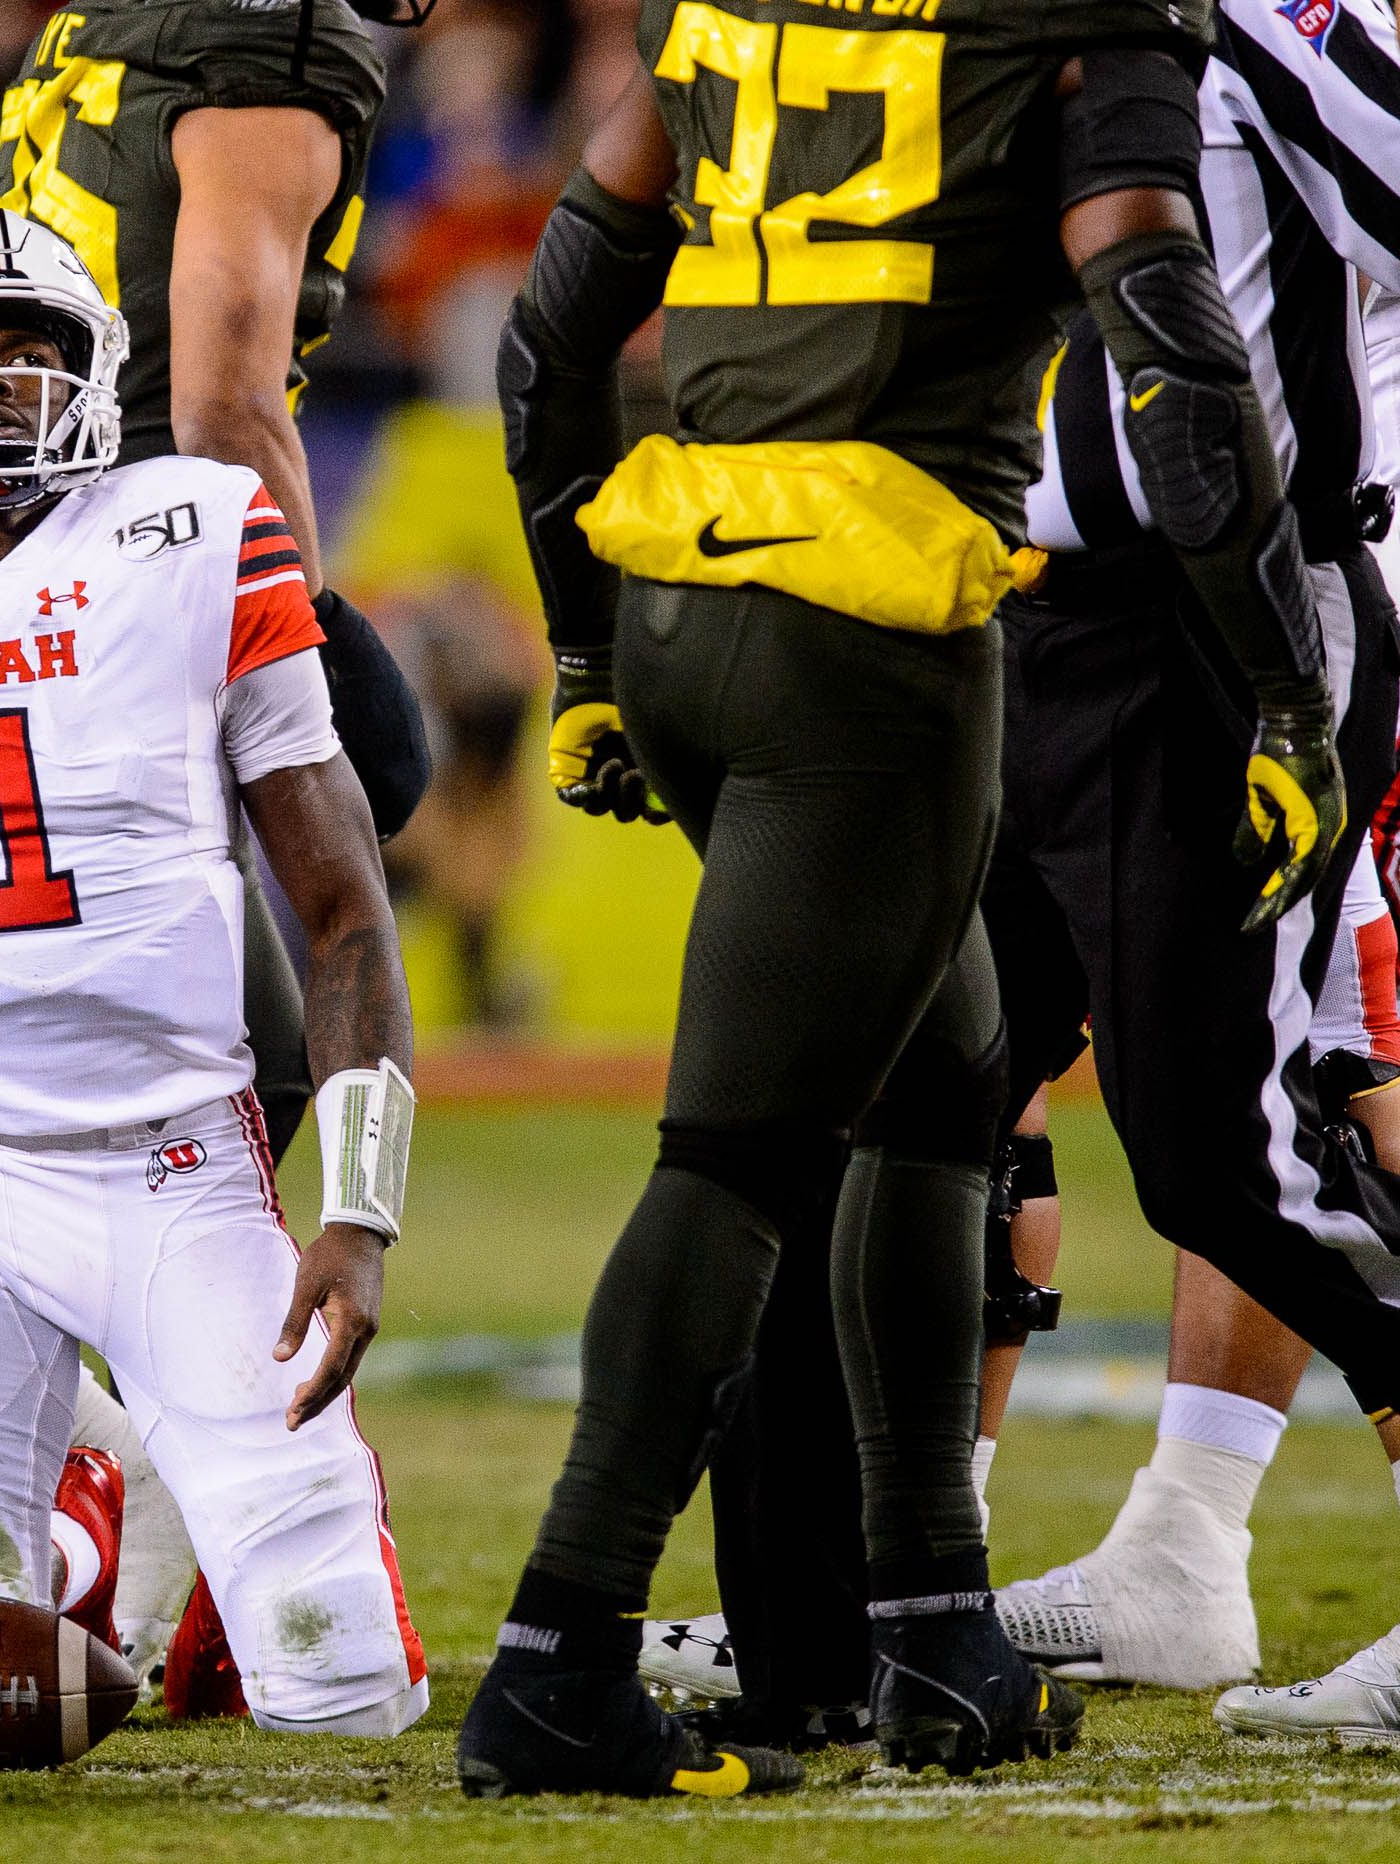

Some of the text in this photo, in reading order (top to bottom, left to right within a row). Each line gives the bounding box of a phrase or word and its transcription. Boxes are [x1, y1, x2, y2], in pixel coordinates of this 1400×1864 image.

[1298, 2, 1331, 33] CFO
[108, 501, 200, 557] 150
[162, 1142, 199, 1170] U
